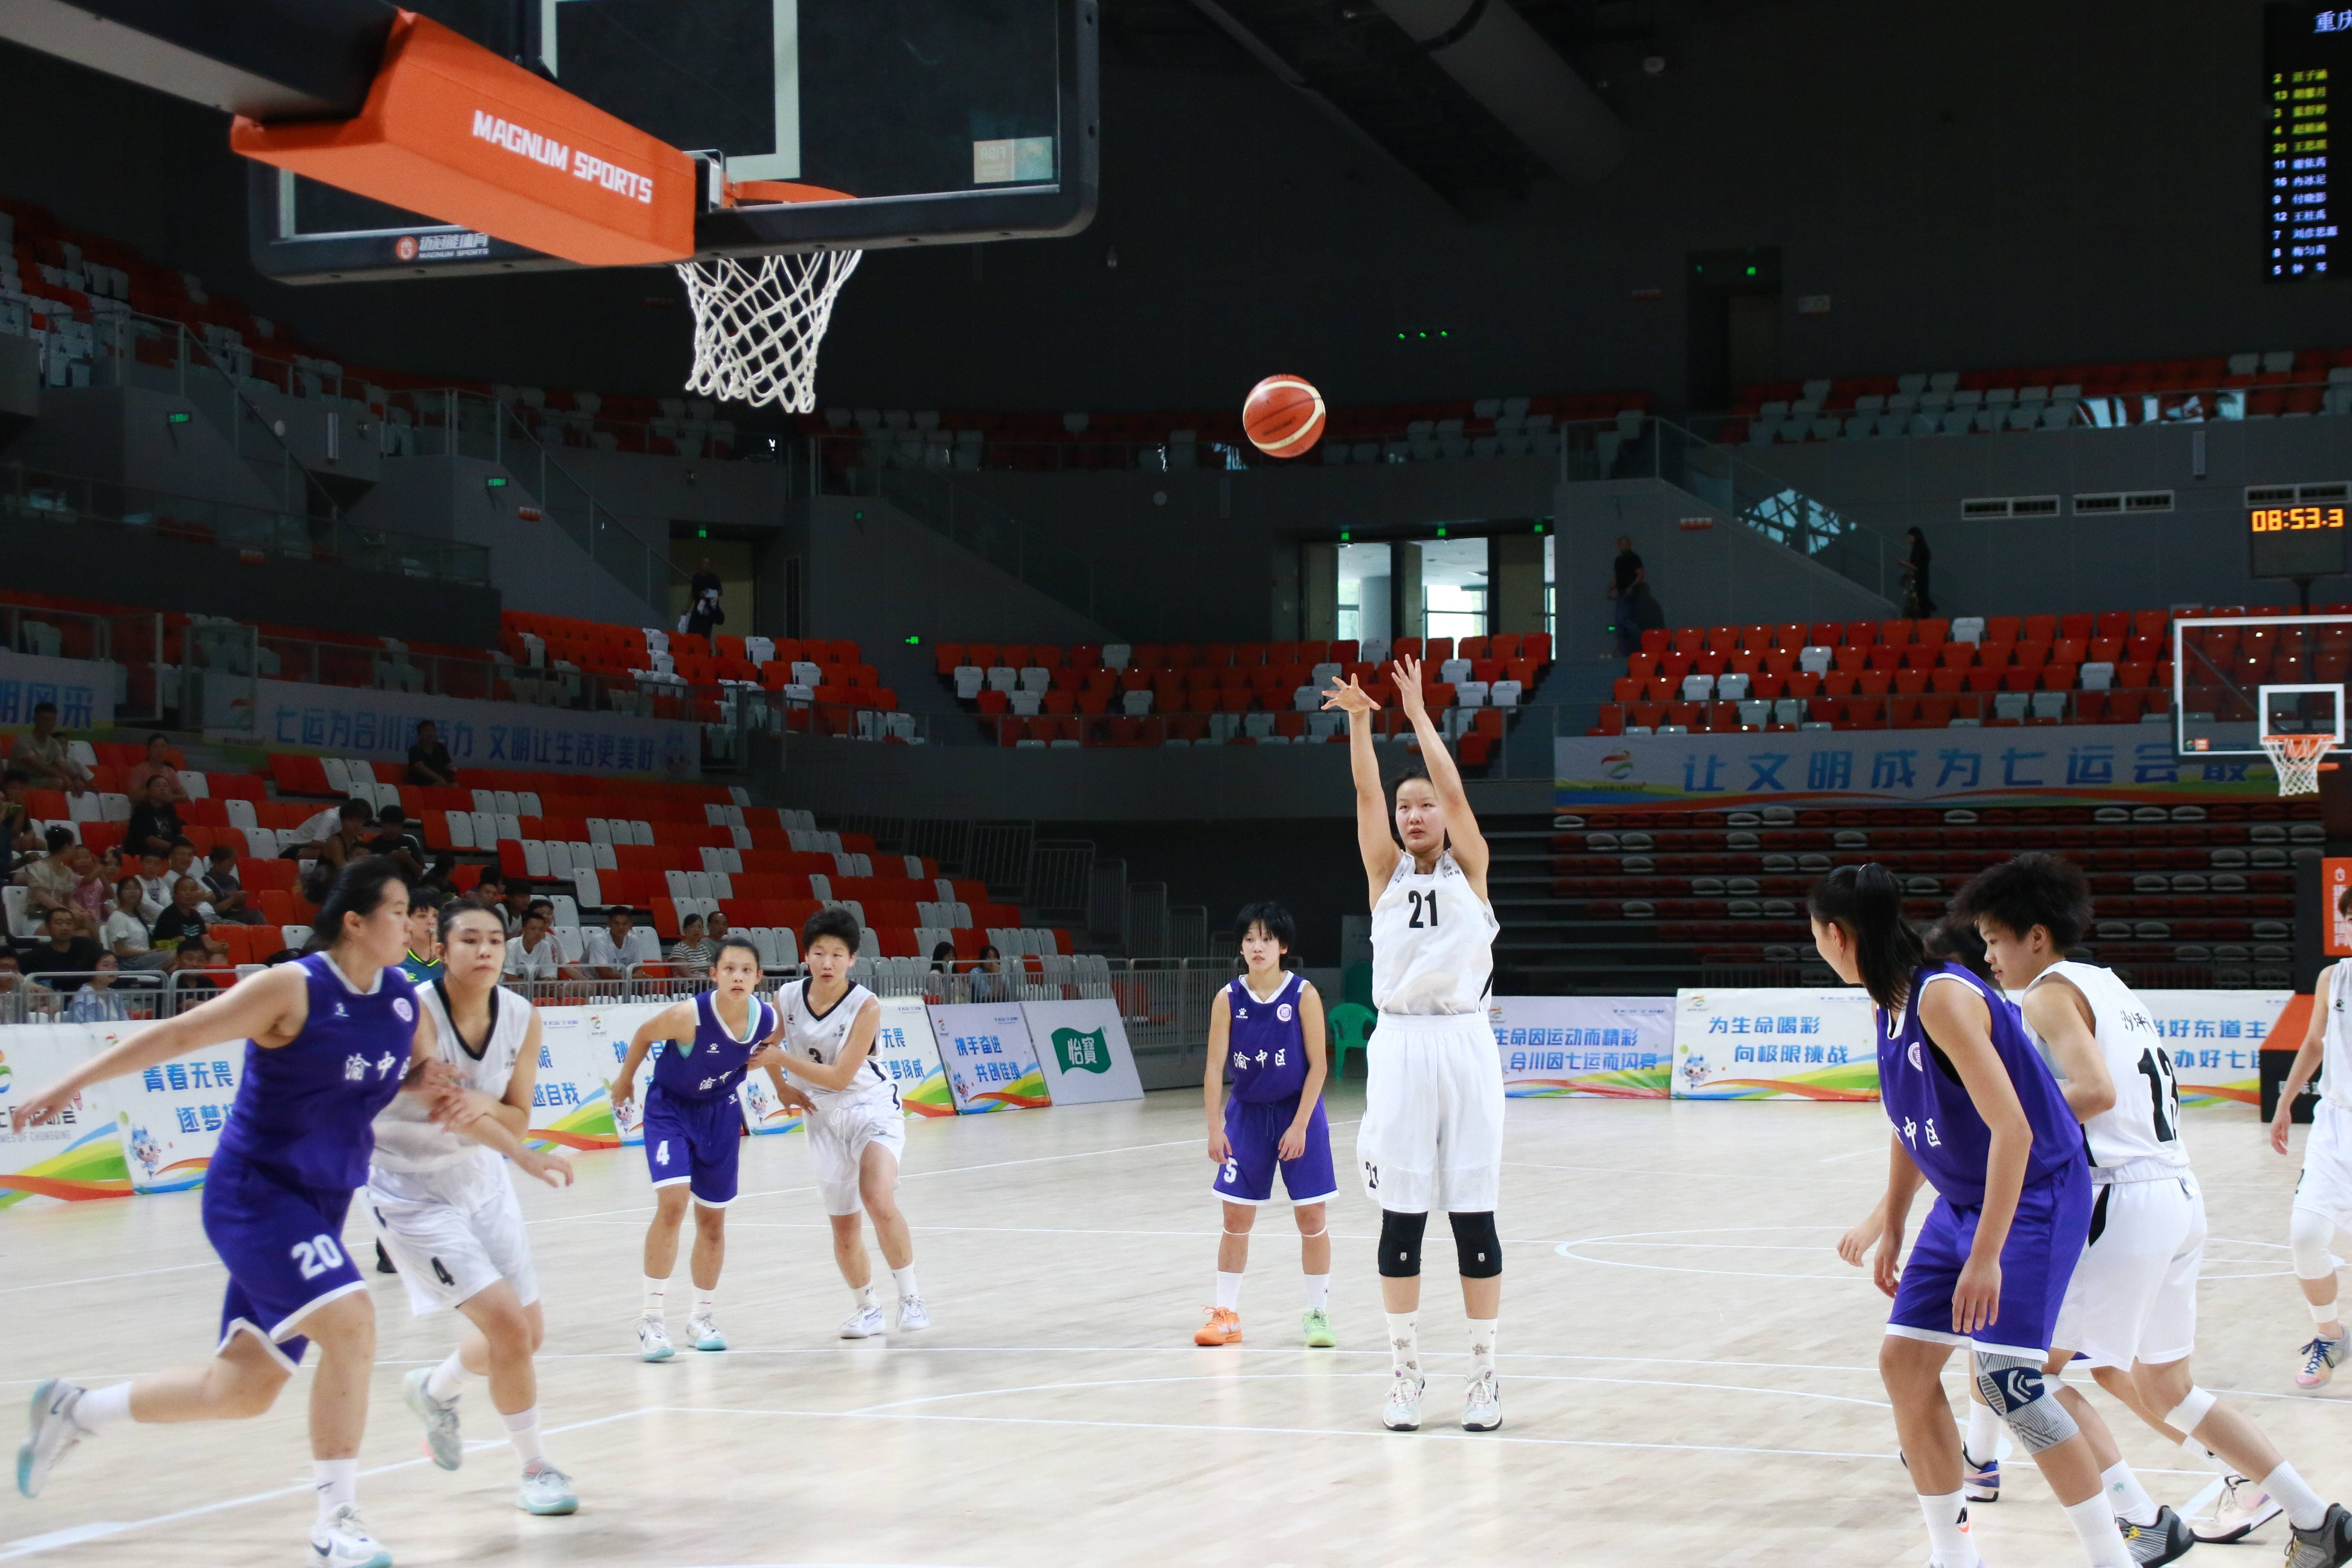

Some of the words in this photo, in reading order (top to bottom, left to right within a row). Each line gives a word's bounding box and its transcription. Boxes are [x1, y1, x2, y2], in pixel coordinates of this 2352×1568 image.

[2273, 74, 2282, 84] 2
[473, 109, 569, 172] MAGNUM
[573, 150, 653, 204] SPORTS
[2273, 142, 2287, 154] 21
[2274, 159, 2286, 170] 11
[2274, 177, 2288, 187] 16
[2274, 211, 2288, 223] 12
[2272, 230, 2282, 241] 7
[419, 250, 453, 259] MAGNUM
[456, 248, 490, 257] SPORTS
[2272, 265, 2282, 276] 5
[2251, 507, 2344, 532] 08:53.3
[489, 725, 655, 771] 文明让生活更美好
[1682, 743, 2282, 792] 让文明成为七运会最
[1408, 889, 1438, 928] 21
[1708, 1016, 1821, 1035] 为生命喝彩
[882, 1028, 906, 1048] 无畏
[955, 1035, 1002, 1056] 携手奋进
[1493, 1028, 1639, 1047] 生命因运动而精彩
[1067, 1036, 1098, 1065] 怡寶
[1233, 1048, 1286, 1070] 渝中区
[1510, 1052, 1658, 1070] 合川因七运而闪亮
[1734, 1044, 1849, 1064] 向极限挑战
[143, 1061, 234, 1092] 青春无畏
[881, 1058, 925, 1080] 梦扬威
[975, 1061, 1022, 1082] 共创佳绩
[656, 1140, 671, 1166] 4
[1223, 1156, 1238, 1184] 5
[1365, 1161, 1379, 1189] 21
[291, 1234, 344, 1280] 20
[432, 1257, 455, 1286] 4
